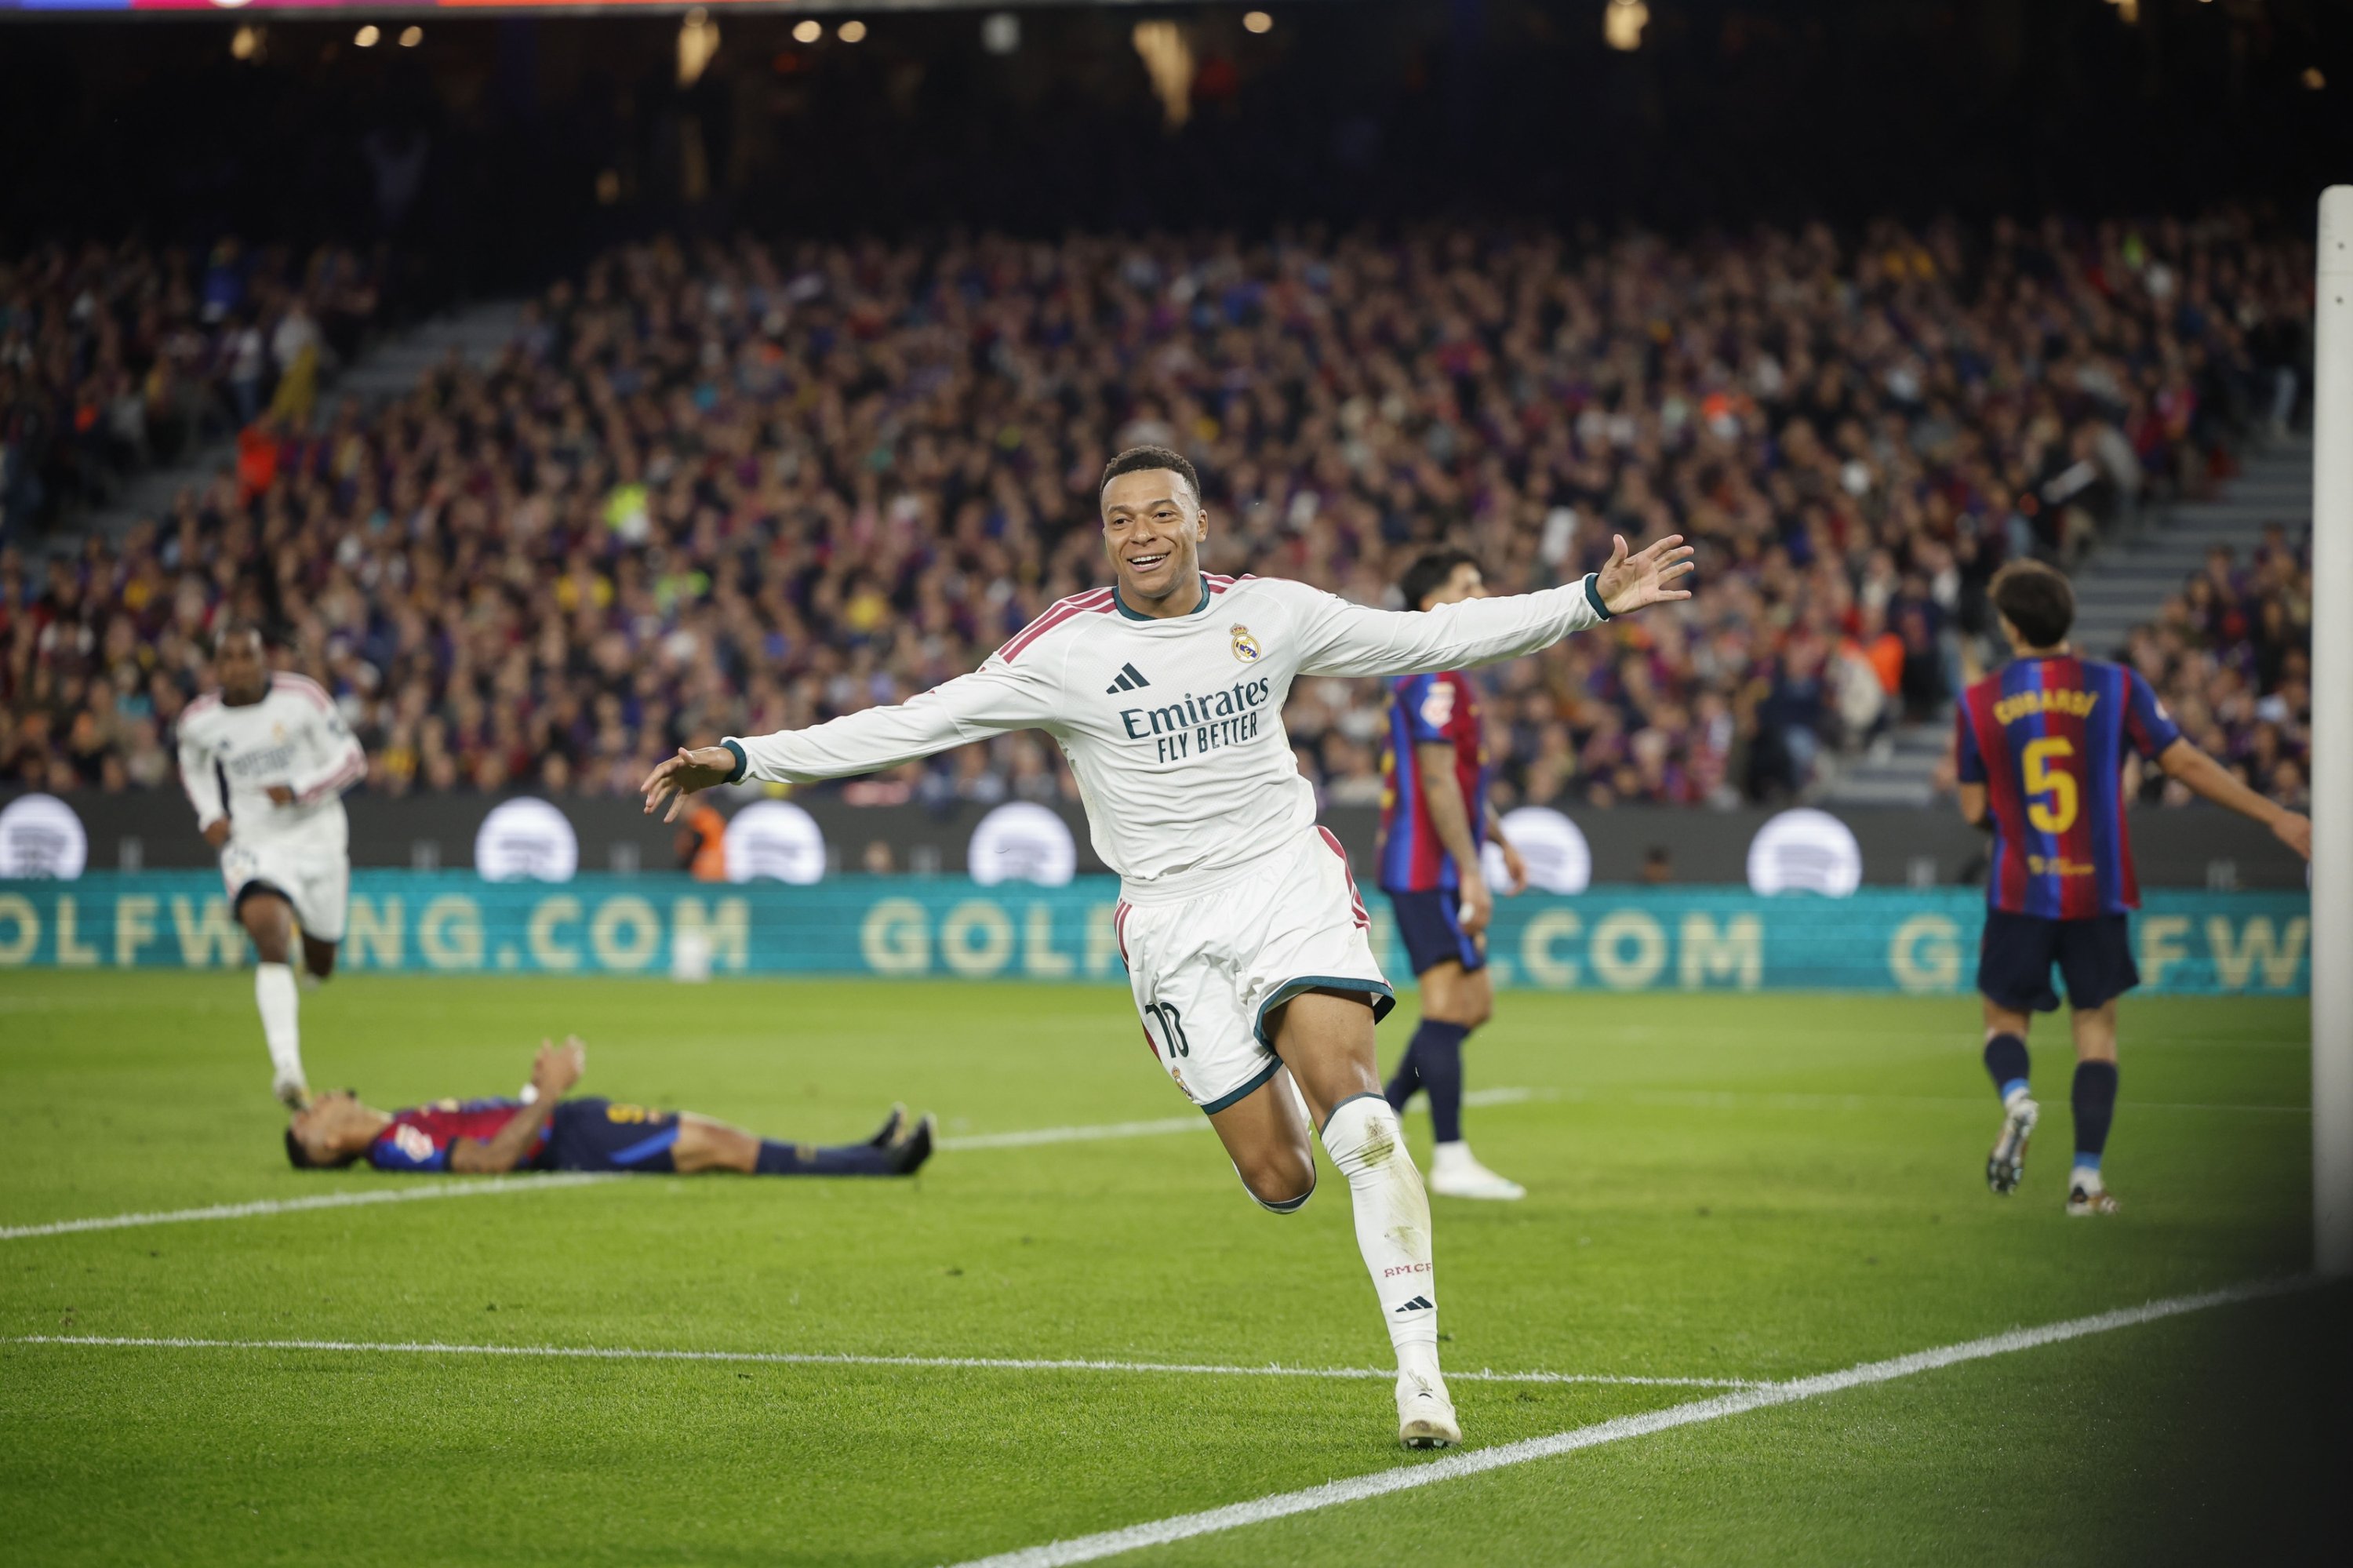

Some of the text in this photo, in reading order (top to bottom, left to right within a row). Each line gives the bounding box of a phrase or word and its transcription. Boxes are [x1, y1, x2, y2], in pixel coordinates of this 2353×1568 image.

[1119, 676, 1269, 740] Emirates
[1158, 711, 1257, 764] FLY BETTER
[2021, 735, 2078, 835] 5
